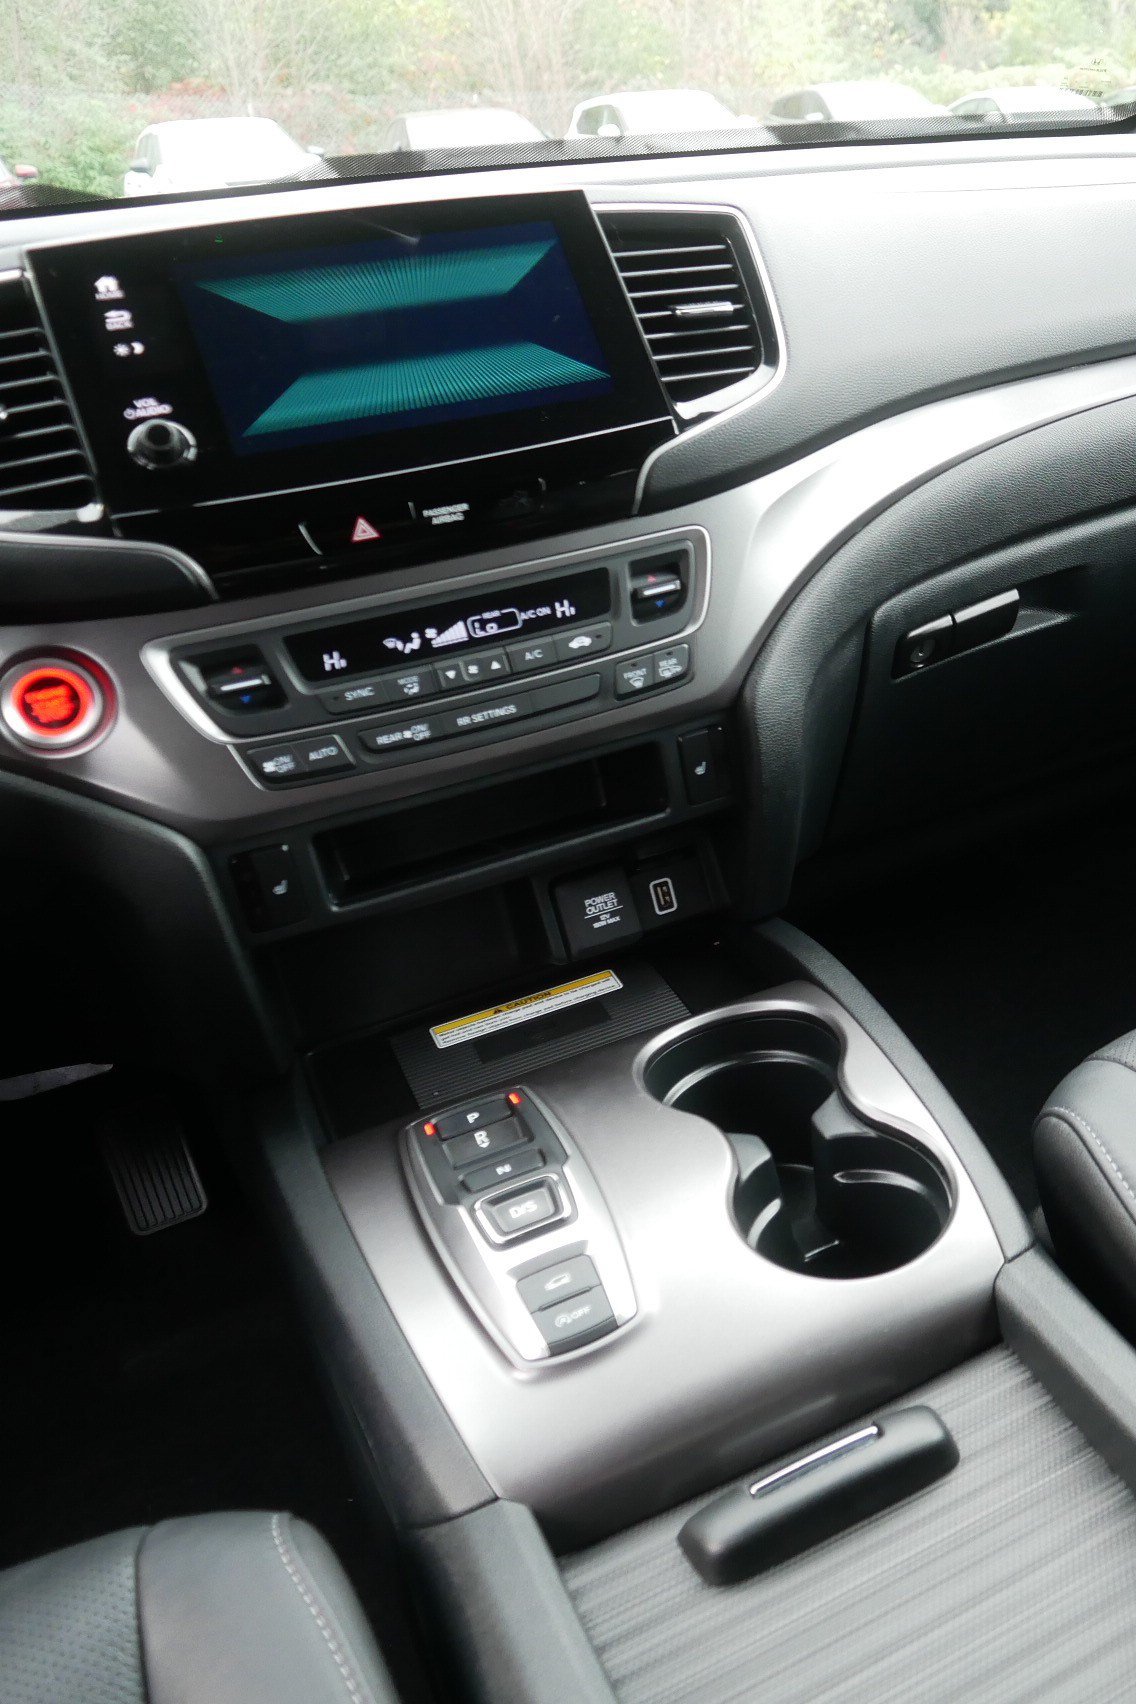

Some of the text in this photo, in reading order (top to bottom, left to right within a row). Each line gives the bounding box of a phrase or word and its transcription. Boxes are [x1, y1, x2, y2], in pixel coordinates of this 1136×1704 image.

[133, 397, 159, 409] VOL
[134, 404, 173, 418] AUDIO
[535, 606, 552, 617] ON
[524, 649, 544, 661] A/C
[622, 668, 647, 680] FRONT
[344, 686, 375, 701] SYNC
[456, 704, 518, 727] RR SETTINGS
[376, 731, 403, 746] REAR
[308, 745, 339, 761] AUTO
[584, 892, 615, 907] POWER
[586, 899, 617, 914] OUTLET
[505, 991, 552, 1010] CAUTION
[467, 1112, 479, 1124] P
[474, 1130, 489, 1146] R
[495, 1163, 512, 1175] N
[509, 1200, 538, 1219] D/S
[569, 1304, 592, 1320] OFF
